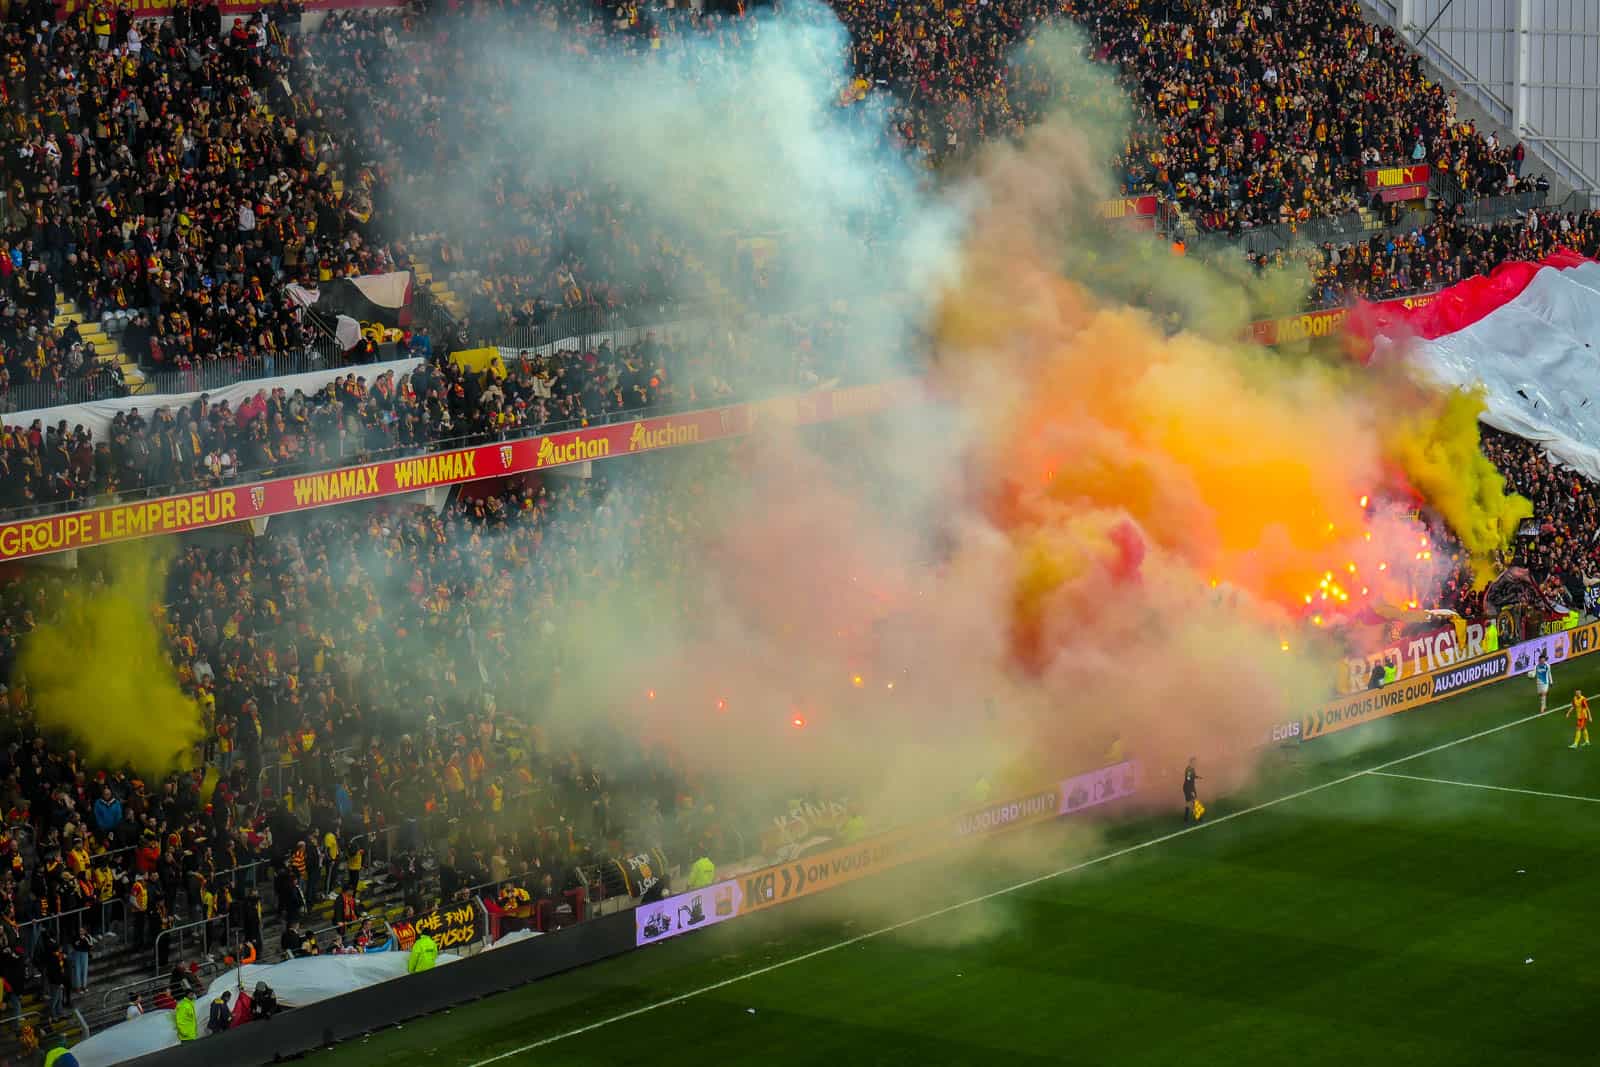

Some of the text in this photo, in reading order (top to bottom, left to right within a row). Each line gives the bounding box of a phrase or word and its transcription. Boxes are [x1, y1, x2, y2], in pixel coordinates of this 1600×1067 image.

[536, 436, 609, 467] Auchan
[629, 422, 699, 451] Auchan
[293, 466, 380, 506] WINAMAX
[394, 450, 476, 489] WINAMAX
[1, 492, 236, 556] GROUPE LEMPEREUR
[1326, 709, 1342, 725] ON
[1344, 698, 1373, 719] VOUS
[1374, 690, 1404, 710] LIVRE
[1405, 681, 1431, 701] QUOI
[1434, 661, 1499, 694] AUJOURD'HUI
[808, 863, 829, 882] ON
